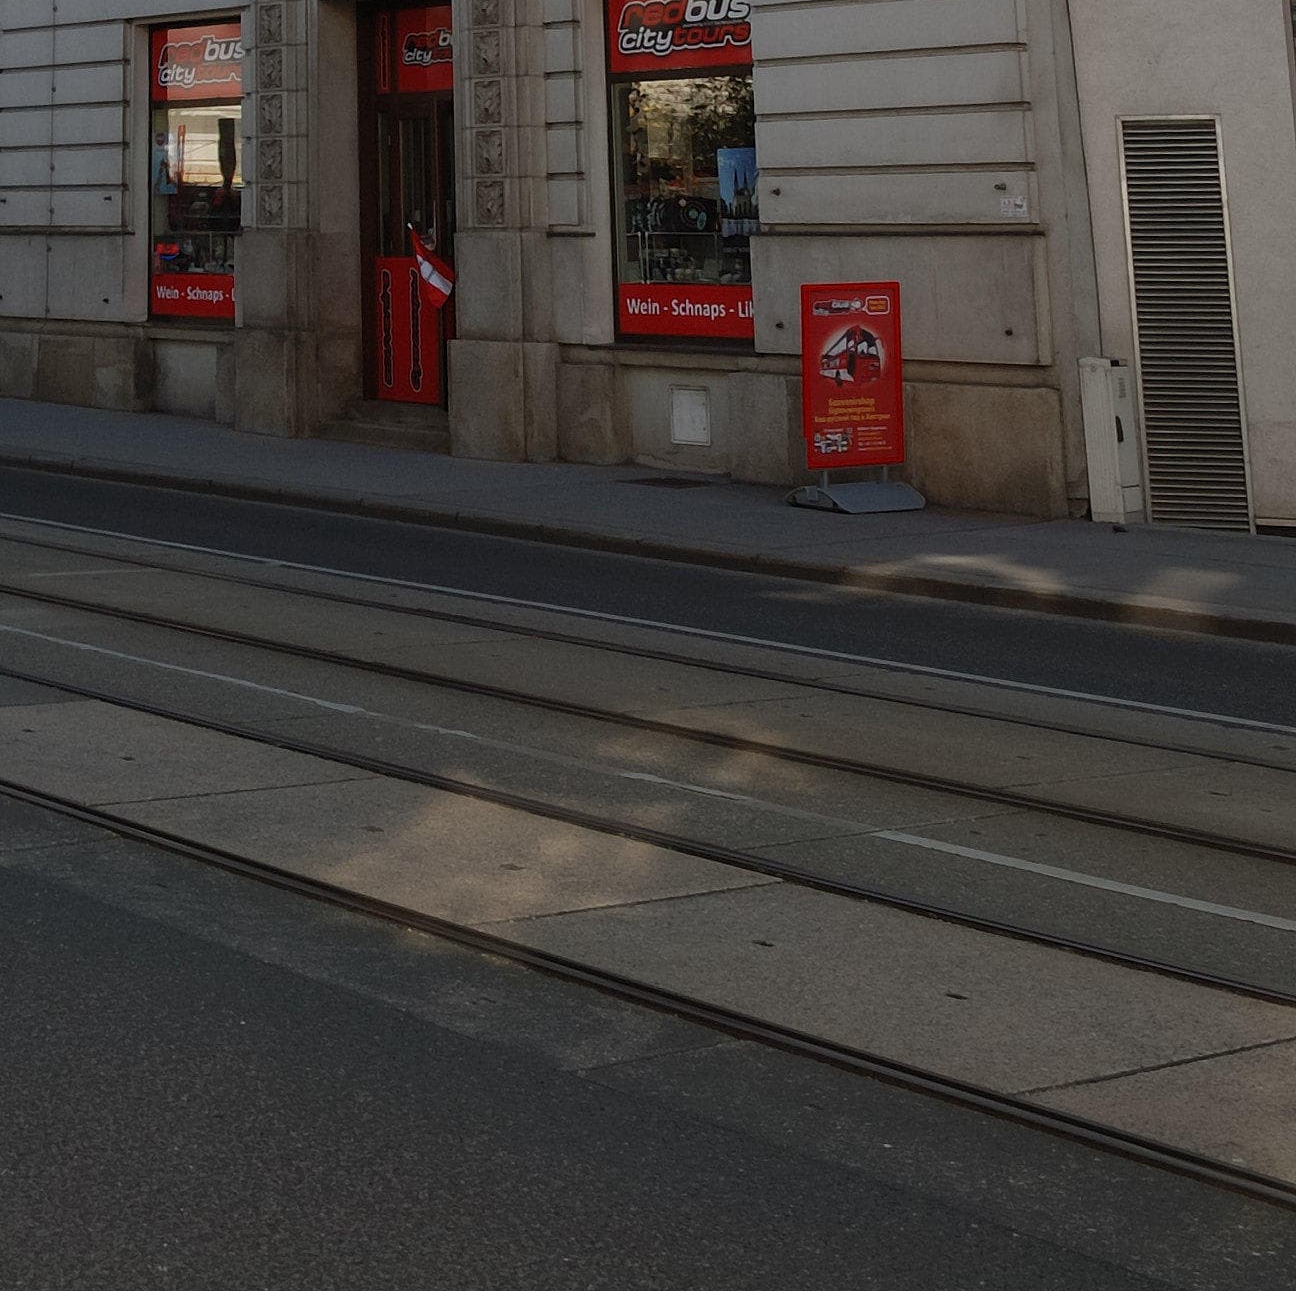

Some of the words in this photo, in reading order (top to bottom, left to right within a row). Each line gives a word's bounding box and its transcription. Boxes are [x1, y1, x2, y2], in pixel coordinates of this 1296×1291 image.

[156, 285, 179, 299] Wein
[187, 286, 224, 304] Schnaps
[626, 298, 660, 315] Wein
[671, 299, 726, 321] Schnaps
